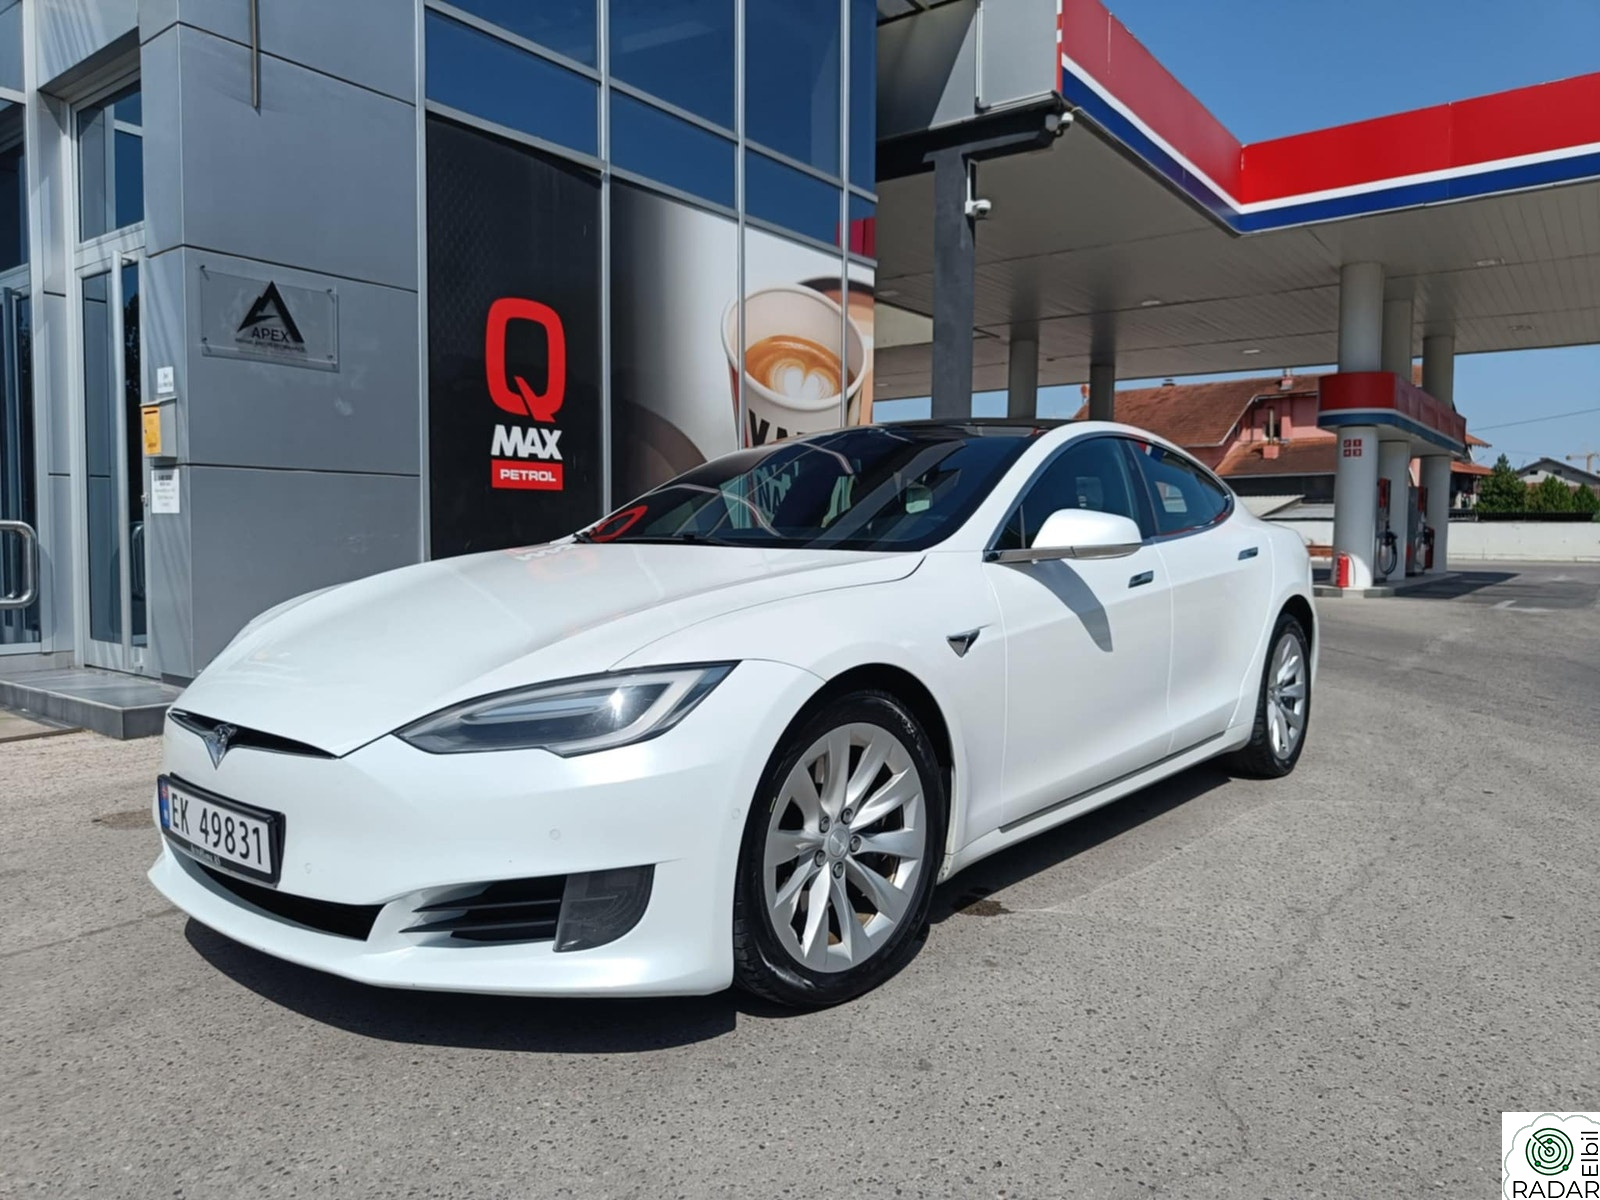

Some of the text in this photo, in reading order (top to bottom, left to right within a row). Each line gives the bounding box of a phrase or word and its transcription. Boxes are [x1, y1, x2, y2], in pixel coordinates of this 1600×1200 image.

[251, 326, 291, 344] APEX
[485, 297, 567, 423] Q
[490, 424, 563, 461] MAX
[499, 468, 557, 483] PETROL
[171, 792, 190, 836] EK
[199, 807, 262, 866] 49831
